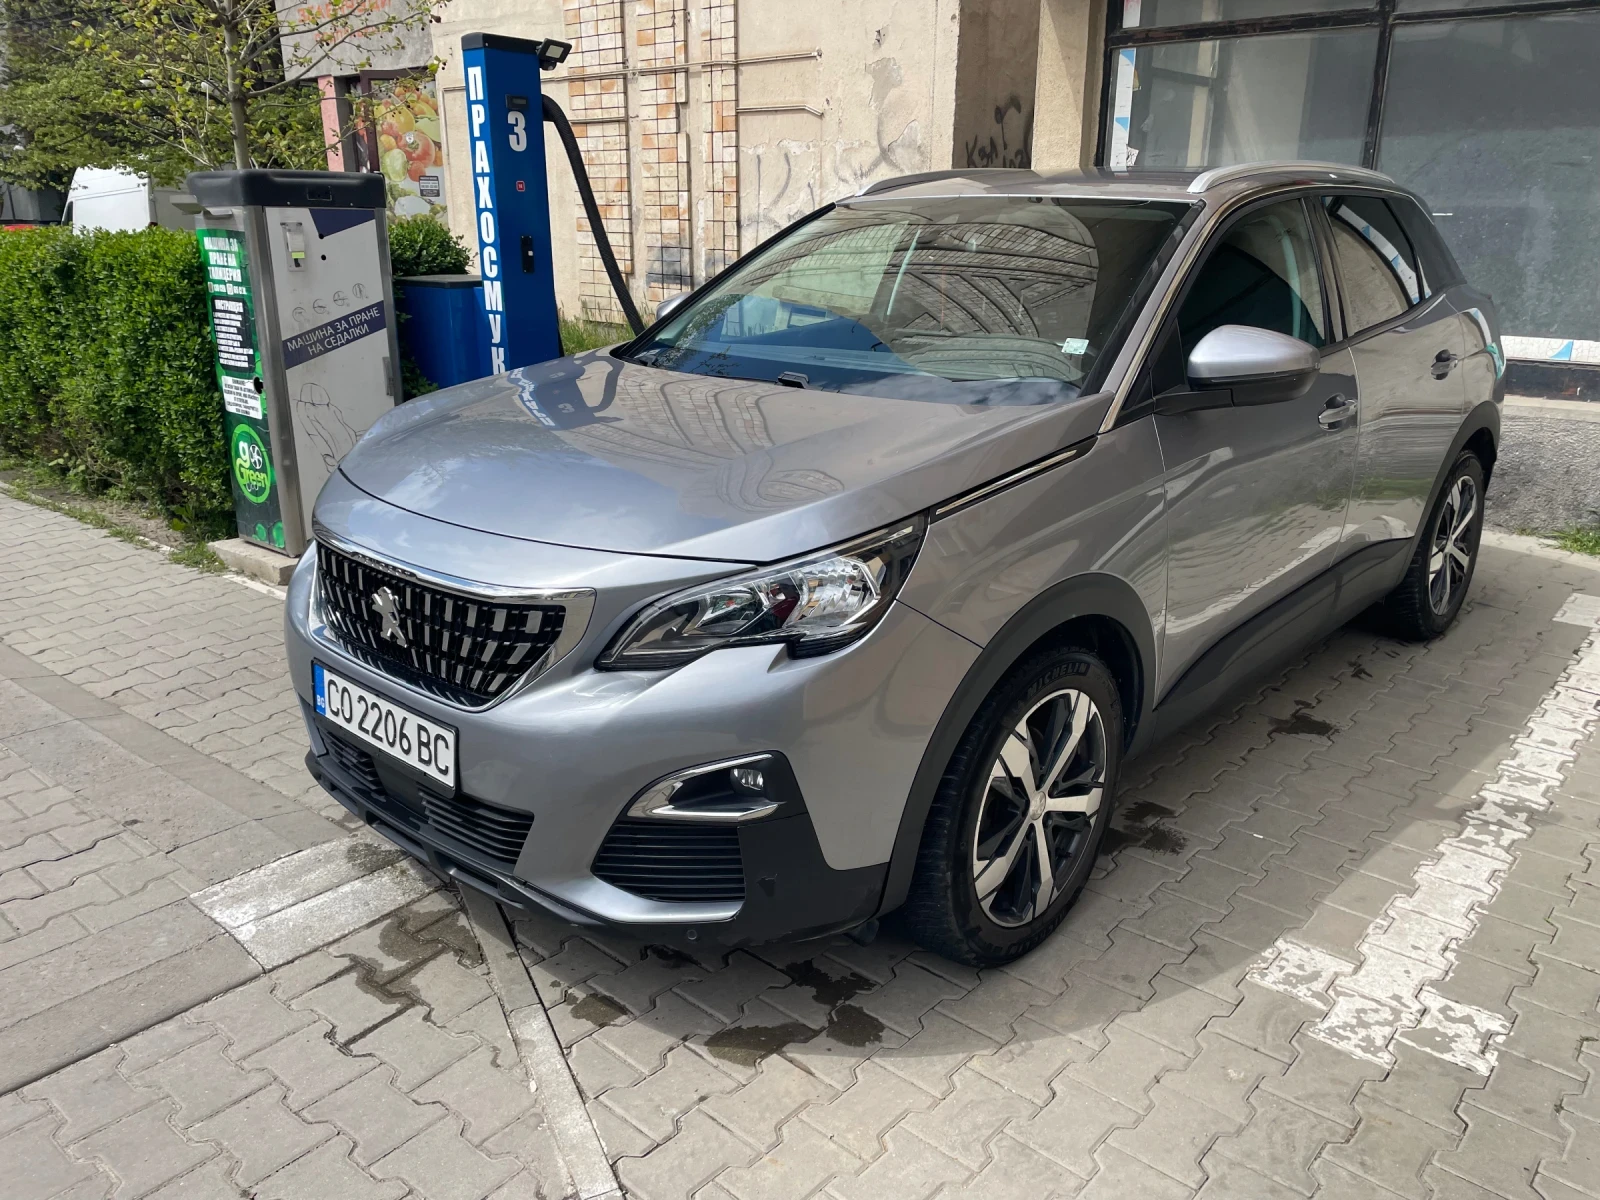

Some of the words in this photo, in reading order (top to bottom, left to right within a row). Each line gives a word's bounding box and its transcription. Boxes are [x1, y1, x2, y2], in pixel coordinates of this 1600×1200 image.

[507, 110, 528, 152] 3
[467, 66, 506, 375] ПРАХОСМУК
[286, 325, 335, 352] МАШИНА
[334, 319, 349, 333] ЗА
[348, 306, 381, 327] ПРАНЕ
[307, 345, 324, 356] НА
[324, 323, 370, 349] СЕДАЛКИ
[316, 694, 325, 708] BG
[1027, 662, 1088, 698] MICHELIN
[327, 679, 353, 724] CO
[357, 694, 412, 756] 2206
[417, 723, 449, 776] BC
